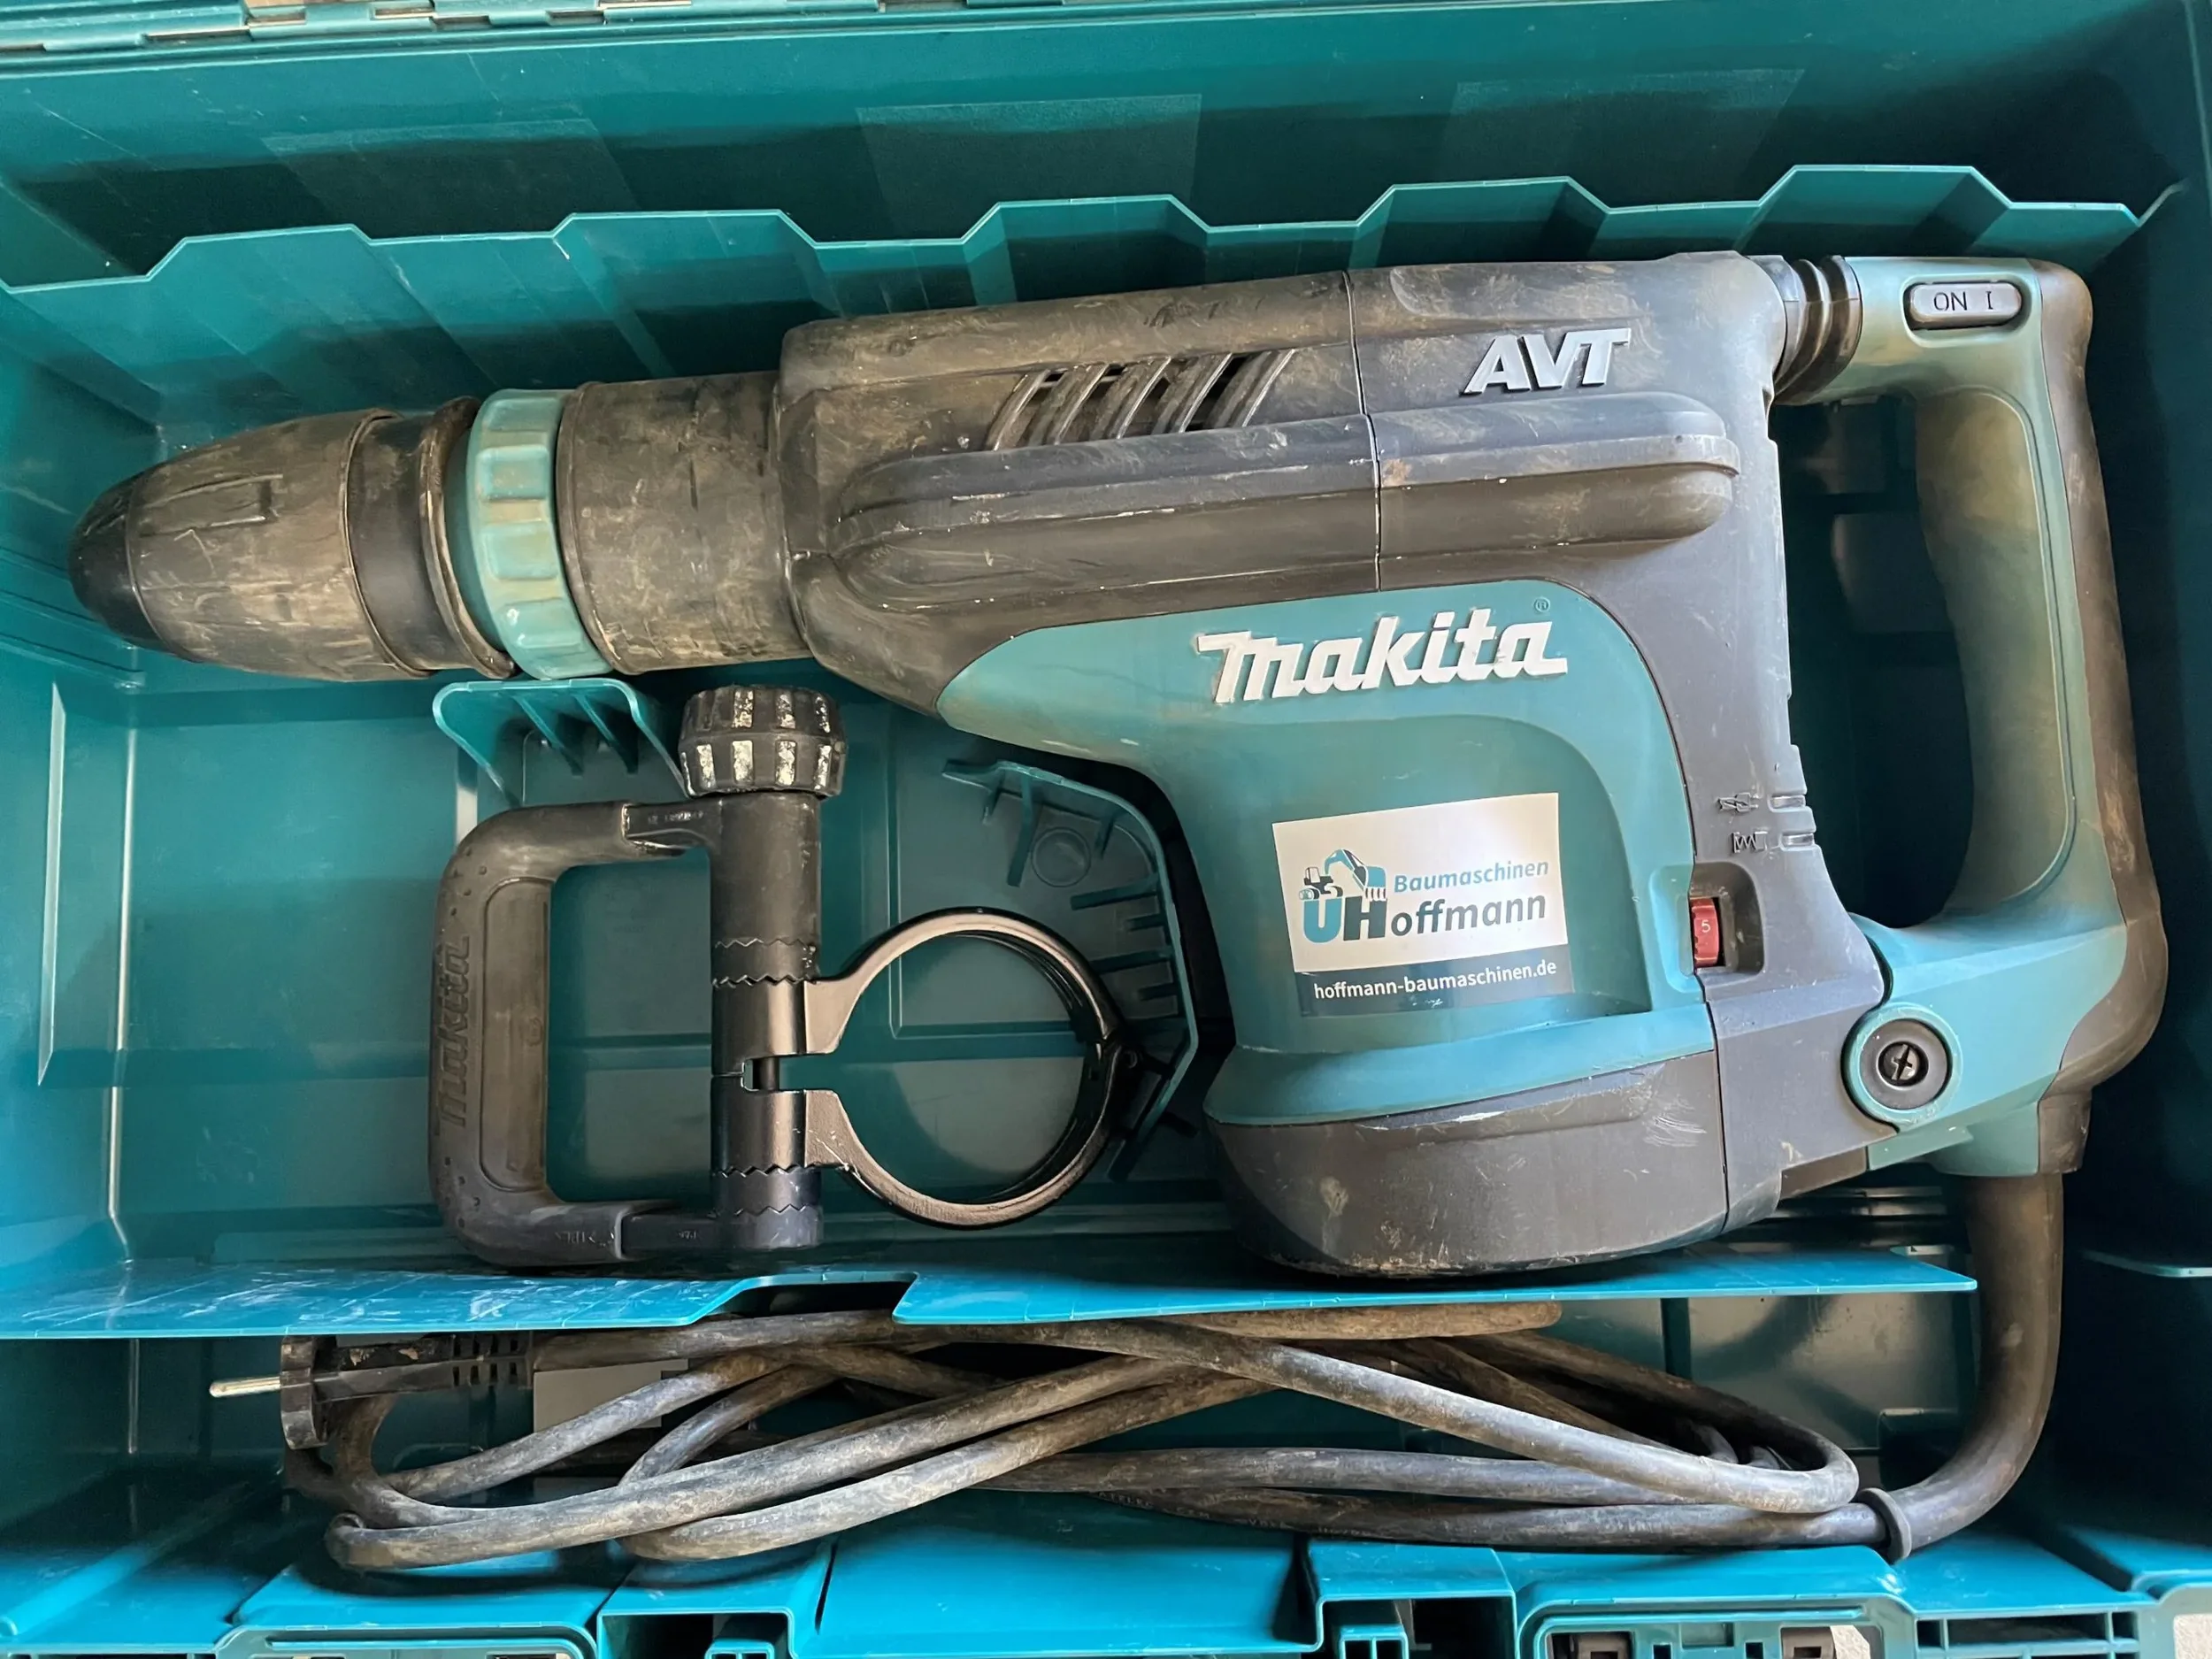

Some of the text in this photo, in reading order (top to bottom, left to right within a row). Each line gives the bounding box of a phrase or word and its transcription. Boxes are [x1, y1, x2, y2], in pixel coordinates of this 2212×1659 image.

[1933, 291, 1967, 311] ON
[1462, 327, 1632, 395] AVT
[1393, 860, 1549, 894] Baumaschinen
[1701, 919, 1711, 933] 5
[1313, 958, 1557, 1001] hoffmann-baumaschinen.de
